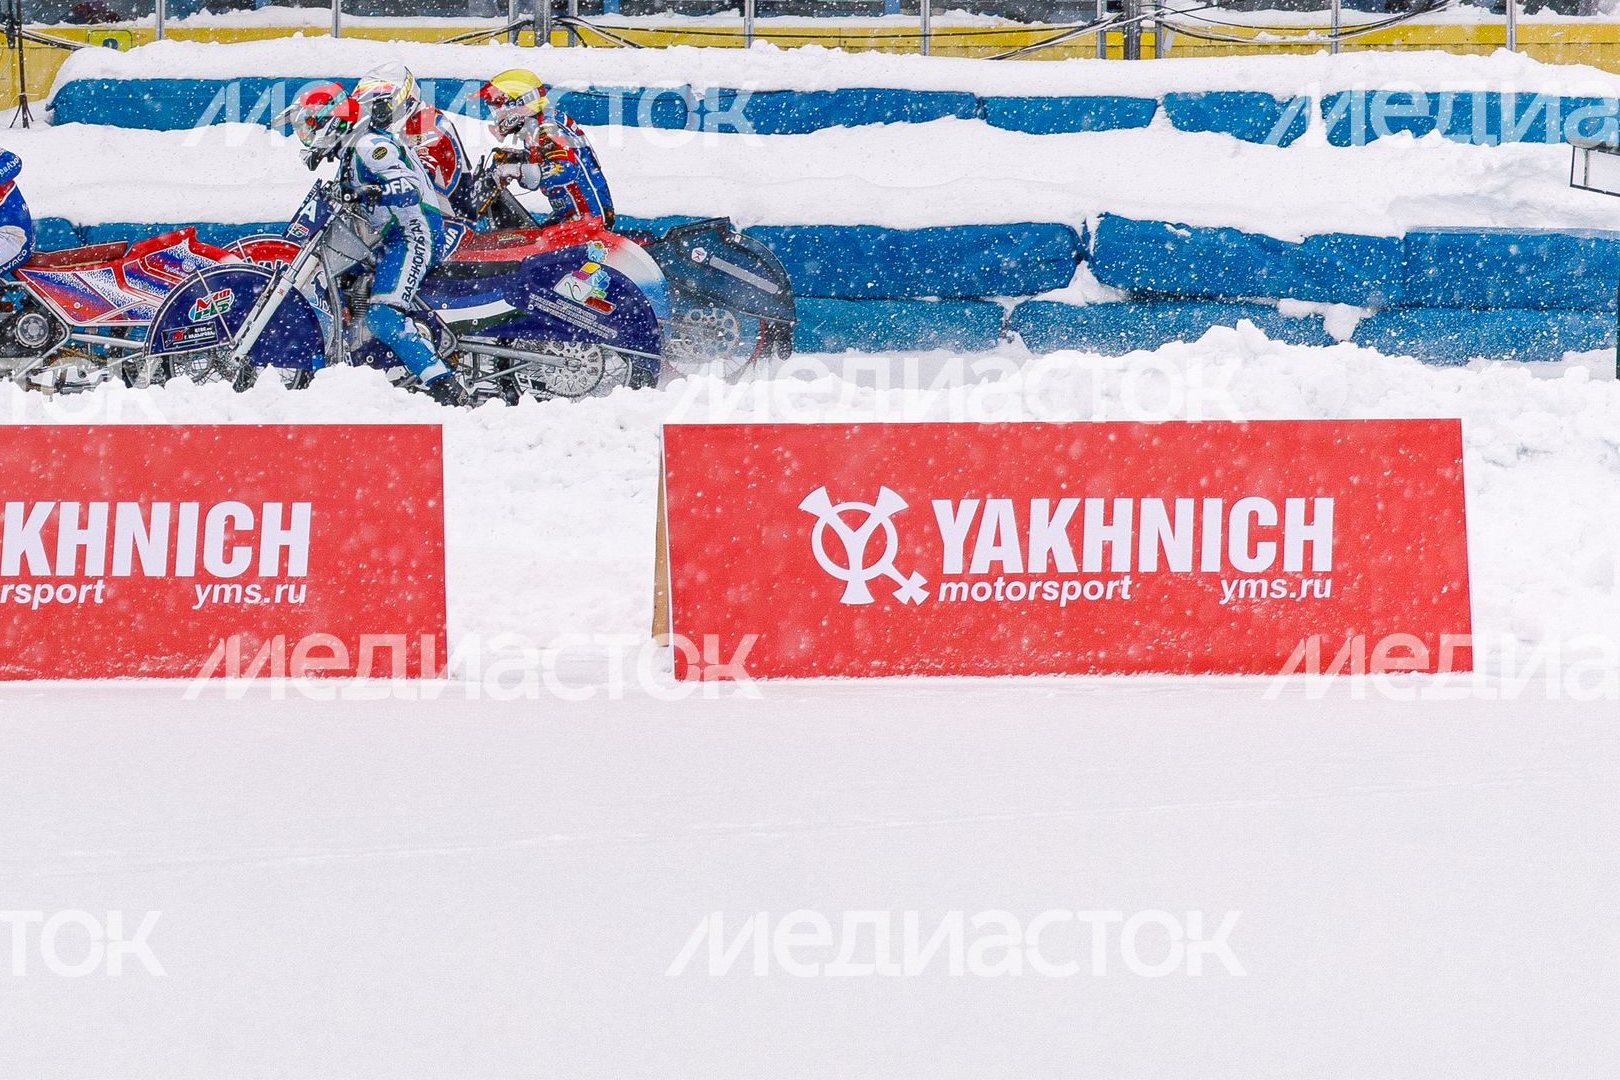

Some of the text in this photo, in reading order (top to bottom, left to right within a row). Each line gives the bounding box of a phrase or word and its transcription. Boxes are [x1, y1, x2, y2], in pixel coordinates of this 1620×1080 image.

[931, 496, 1332, 573] YAKHNICH
[191, 582, 307, 609] yms.ru
[939, 574, 1332, 606] motorsport yms.ru
